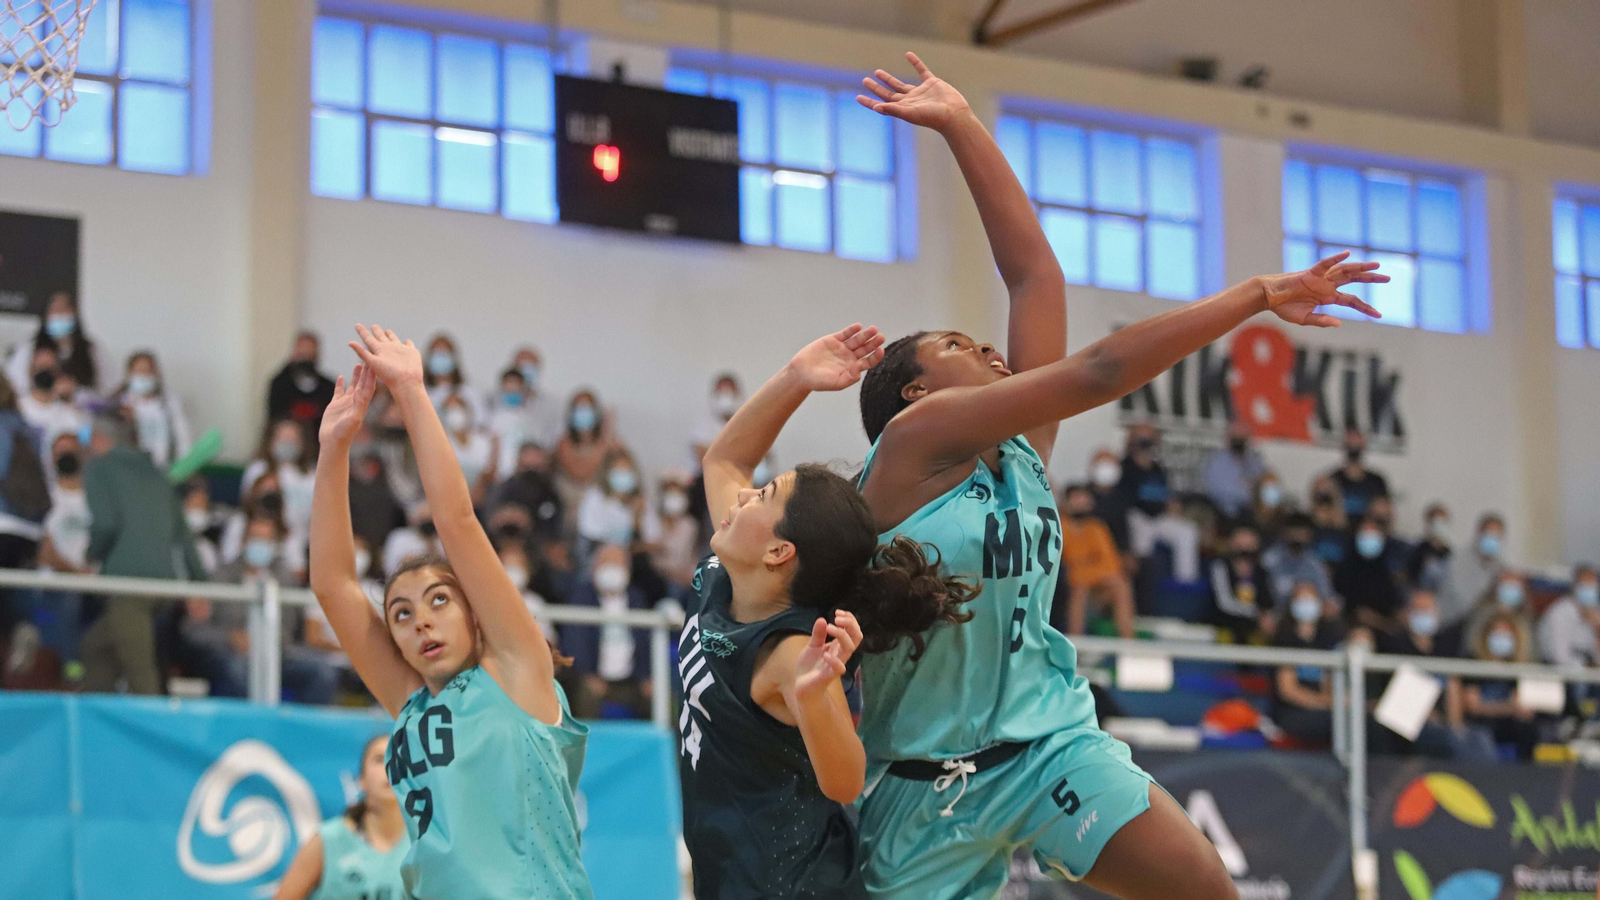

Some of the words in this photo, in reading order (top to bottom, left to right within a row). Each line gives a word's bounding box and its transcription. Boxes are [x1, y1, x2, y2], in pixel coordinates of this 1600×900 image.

[405, 786, 434, 840] 9
[1051, 778, 1081, 816] 5
[1076, 810, 1099, 843] vive
